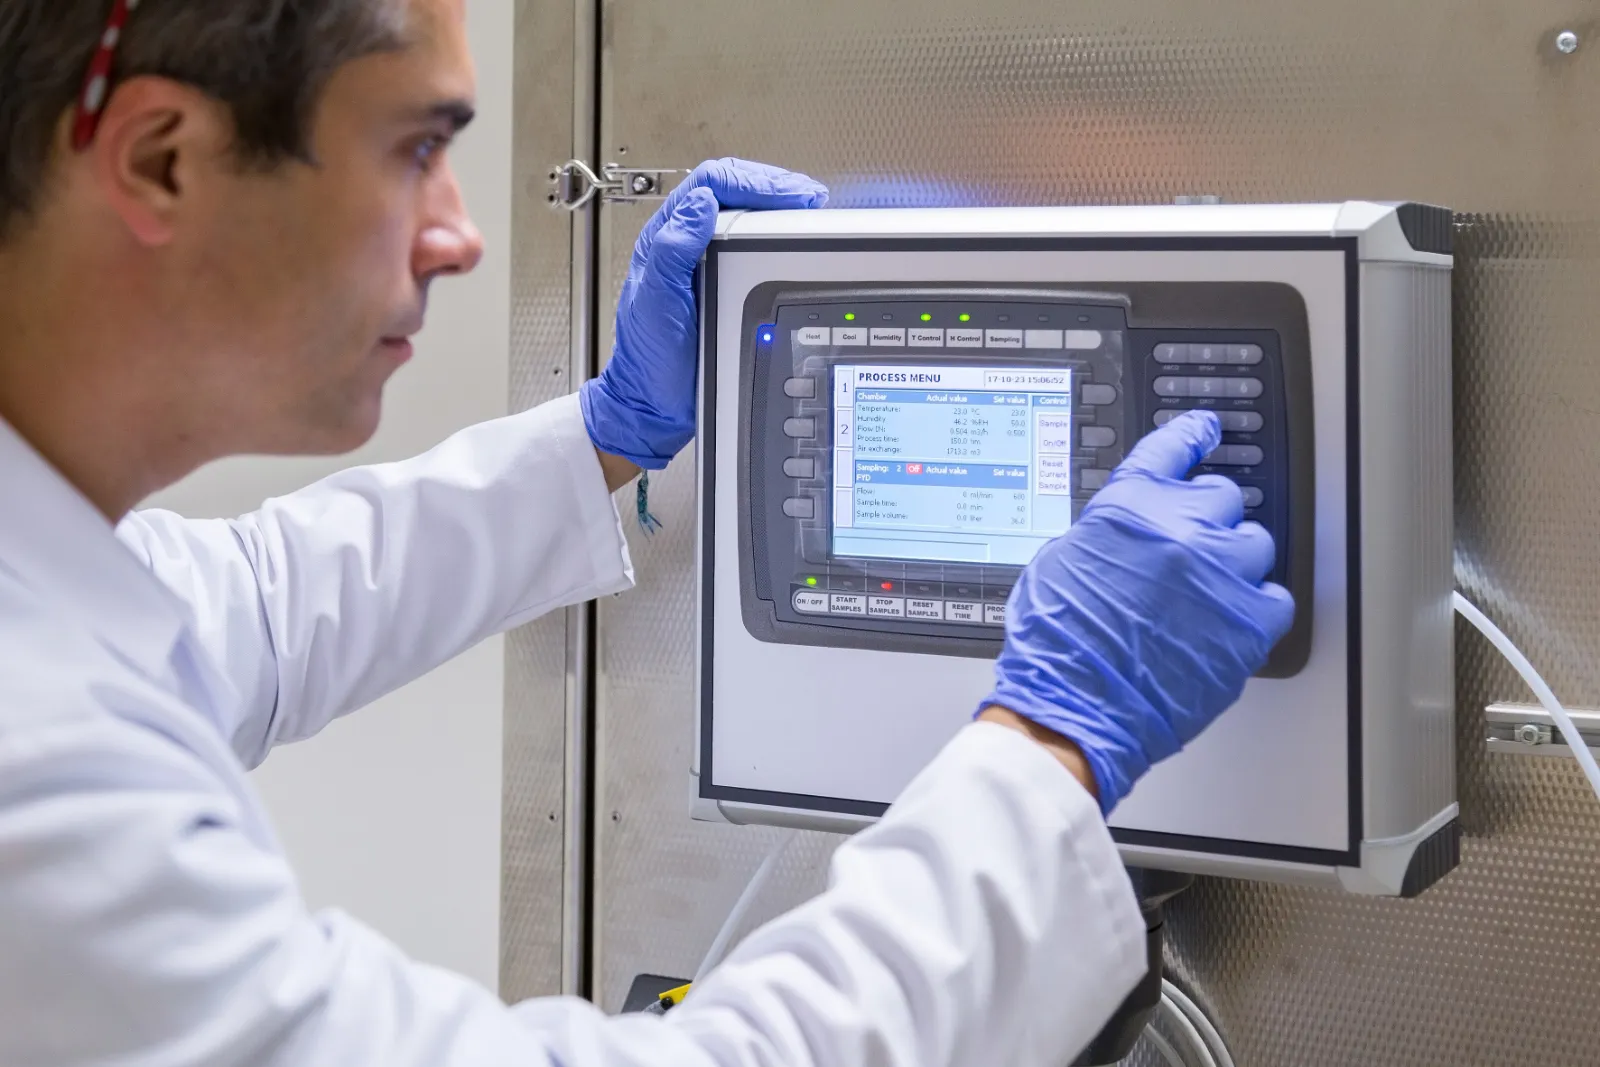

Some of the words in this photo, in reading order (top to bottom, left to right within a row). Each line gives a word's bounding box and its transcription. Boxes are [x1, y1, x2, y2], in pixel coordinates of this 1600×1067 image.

[873, 334, 902, 342] Humidity
[990, 336, 1020, 344] Sampling
[1167, 347, 1174, 358] 7
[1203, 348, 1211, 359] 8
[1240, 348, 1248, 360] 9
[859, 373, 907, 382] PROCESS
[910, 374, 941, 383] MENU
[842, 382, 848, 393] 1
[1167, 381, 1174, 391] 4
[1203, 381, 1211, 392] 5
[1240, 382, 1248, 393] 6
[857, 393, 887, 401] Chamber
[949, 395, 968, 403] value
[1006, 396, 1026, 404] value
[1039, 396, 1067, 405] Control
[857, 405, 901, 413] Temperature:
[953, 408, 968, 416] 23.0
[1011, 409, 1026, 417] 23.0
[840, 423, 849, 435] 2
[857, 425, 874, 433] Flow
[1040, 419, 1068, 429] Sample
[857, 434, 882, 443] Process
[883, 435, 900, 443] time:
[1043, 440, 1067, 448] On/Off
[857, 444, 867, 452] Air
[868, 445, 902, 455] exchange:
[970, 448, 981, 456] m3
[1042, 459, 1064, 468] Reset
[856, 463, 889, 473] Sampling:
[896, 465, 902, 473] 2
[908, 465, 920, 473] Off
[949, 466, 968, 475] value
[993, 468, 1005, 476] Set
[1006, 468, 1026, 477] value
[1039, 470, 1067, 478] Current
[1038, 481, 1067, 491] Sample
[856, 498, 880, 507] Sample
[881, 499, 898, 507] time:
[970, 503, 983, 511] min
[856, 510, 880, 519] Sample
[881, 512, 908, 520] volume:
[836, 596, 857, 604] START
[831, 605, 862, 613] SAMPLES
[952, 603, 974, 611] RESET
[987, 605, 1005, 613] PROC
[954, 612, 971, 620] TIME
